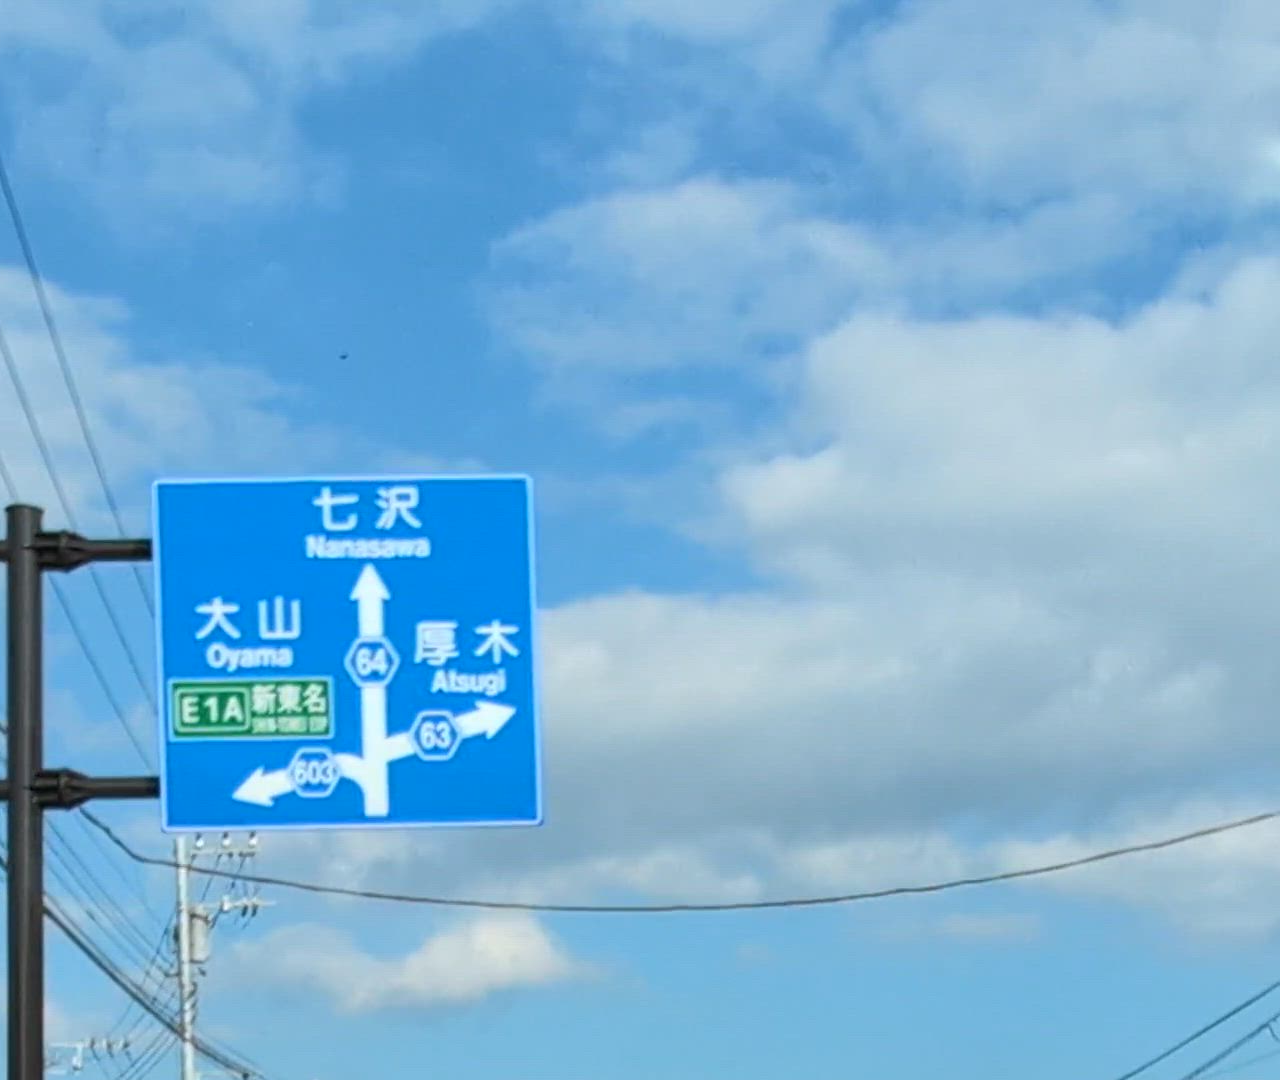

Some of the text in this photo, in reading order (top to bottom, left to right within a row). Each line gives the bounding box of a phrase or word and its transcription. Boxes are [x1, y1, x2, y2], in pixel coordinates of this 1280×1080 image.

[313, 486, 422, 530] 七沢
[306, 536, 431, 559] Nanasawa
[195, 596, 301, 640] 大山
[414, 620, 520, 664] 厚木
[206, 644, 294, 672] Oyama
[354, 650, 389, 676] 64
[431, 669, 507, 695] Atsugi
[181, 696, 244, 724] E1A
[251, 684, 327, 715] 新東名
[417, 721, 452, 750] 63
[293, 760, 336, 786] 603
